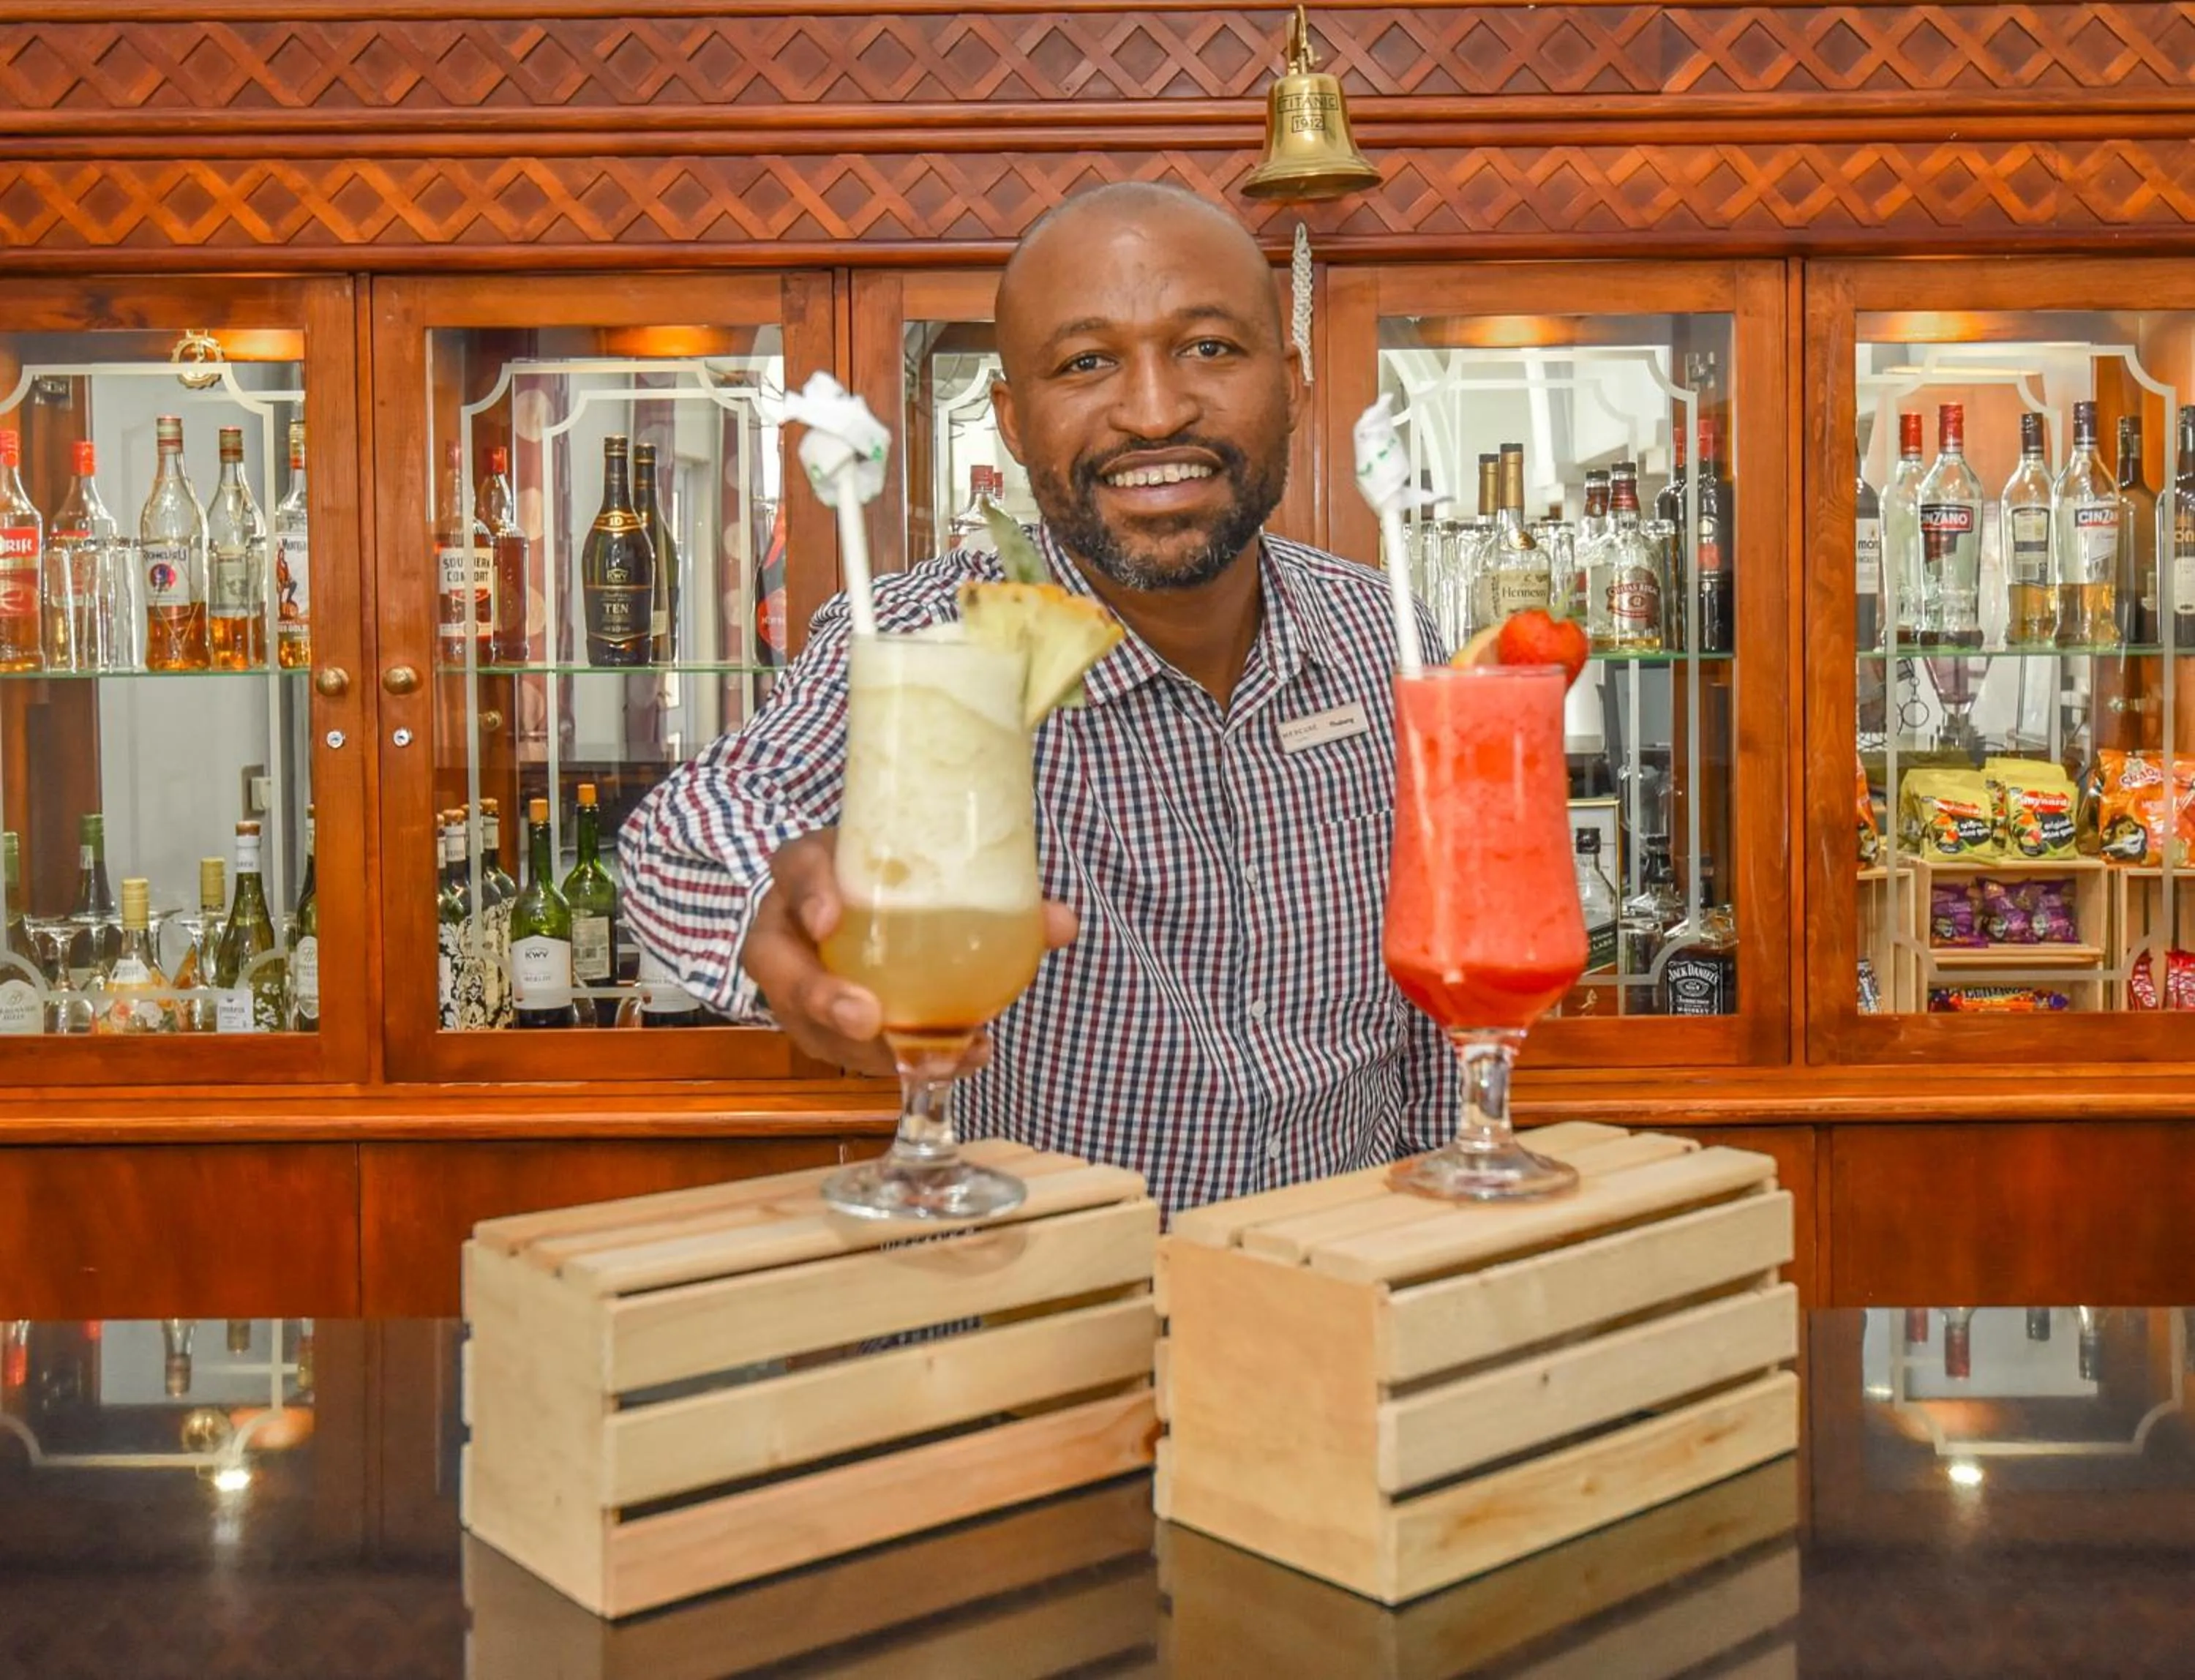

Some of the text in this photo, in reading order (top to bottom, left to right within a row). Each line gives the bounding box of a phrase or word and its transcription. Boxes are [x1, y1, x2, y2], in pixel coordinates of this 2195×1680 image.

[1283, 96, 1335, 108] TITANIC
[1294, 117, 1323, 130] 1912
[609, 515, 624, 527] 10
[603, 603, 629, 614] TEN
[525, 950, 549, 959] KWV
[1668, 967, 1688, 982] JACK
